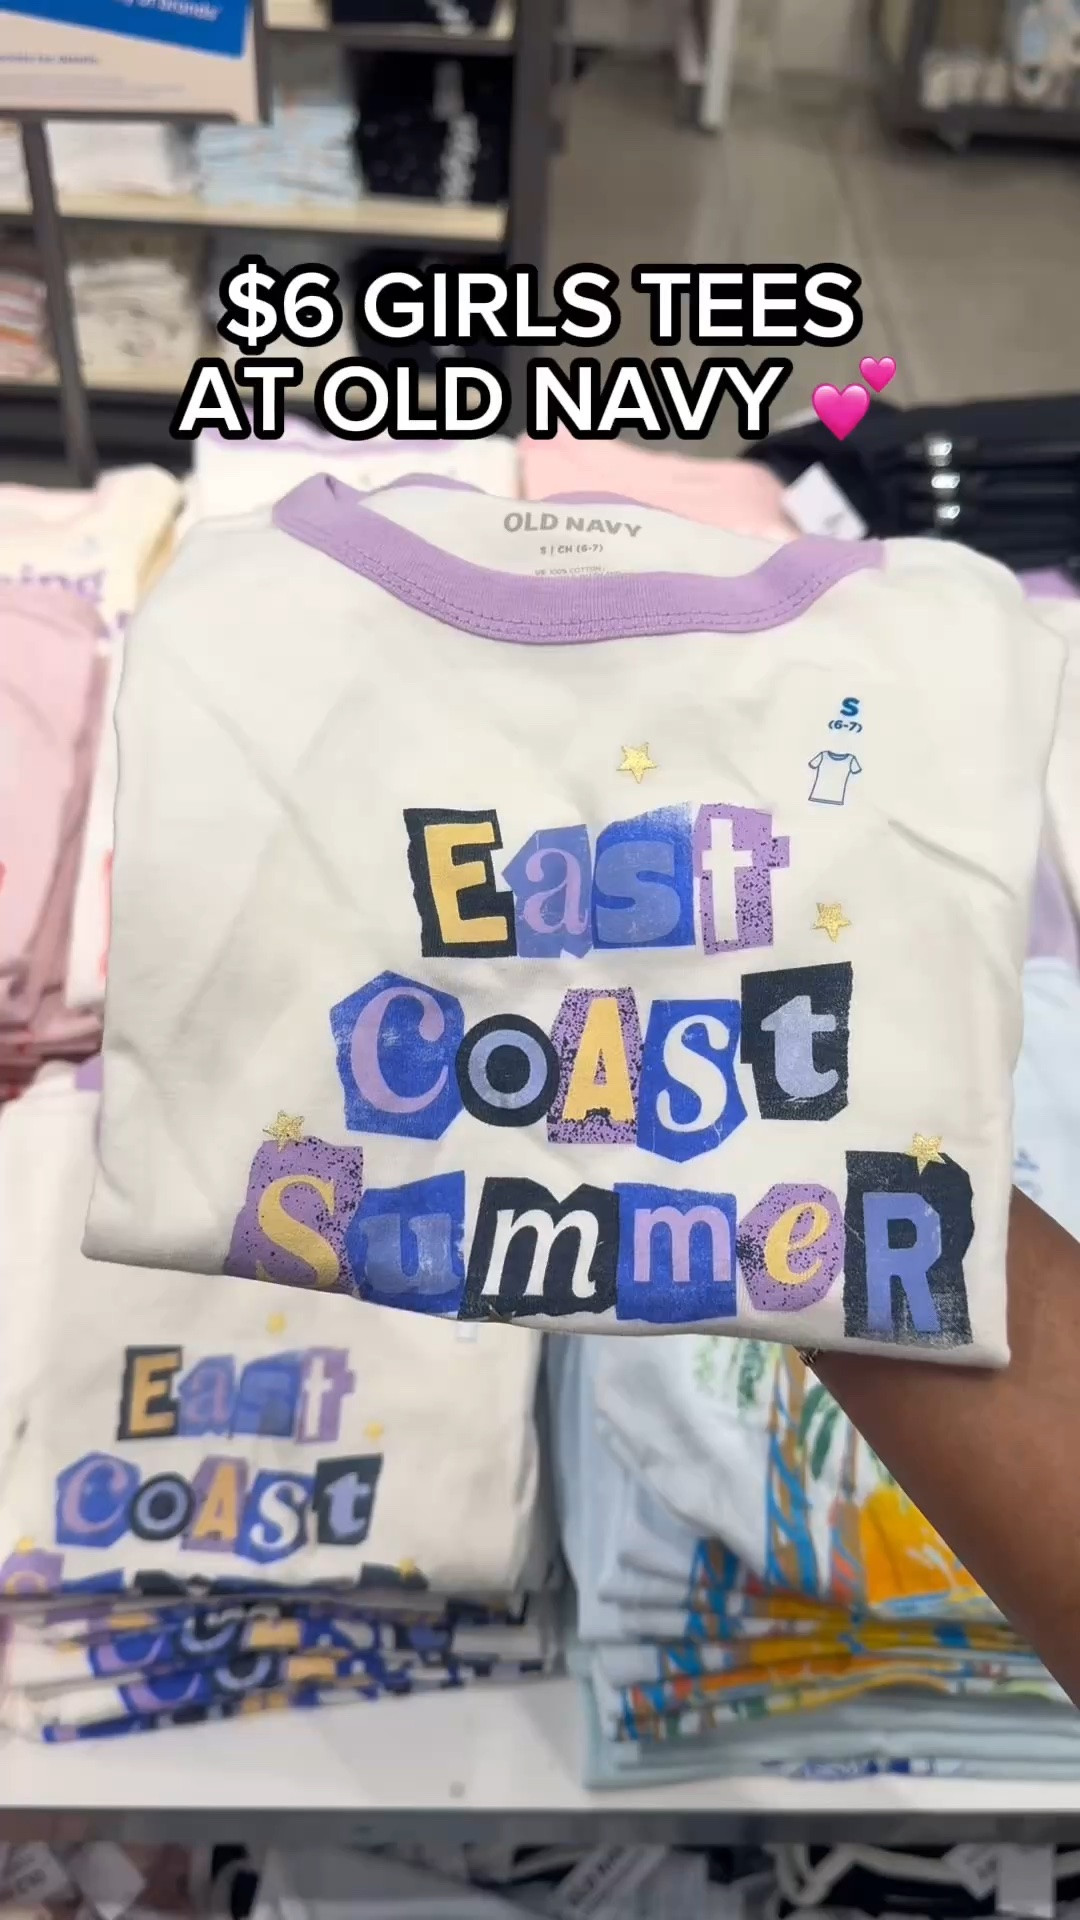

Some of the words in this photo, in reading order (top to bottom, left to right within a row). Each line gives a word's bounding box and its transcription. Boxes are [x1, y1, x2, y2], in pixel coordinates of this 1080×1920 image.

[503, 511, 559, 533] OLD
[565, 516, 642, 537] NAVY
[539, 546, 547, 555] S
[557, 545, 573, 554] CH
[576, 543, 604, 553] (6-7)
[840, 697, 860, 717] S
[828, 719, 863, 734] (6-7)
[421, 813, 760, 949] East
